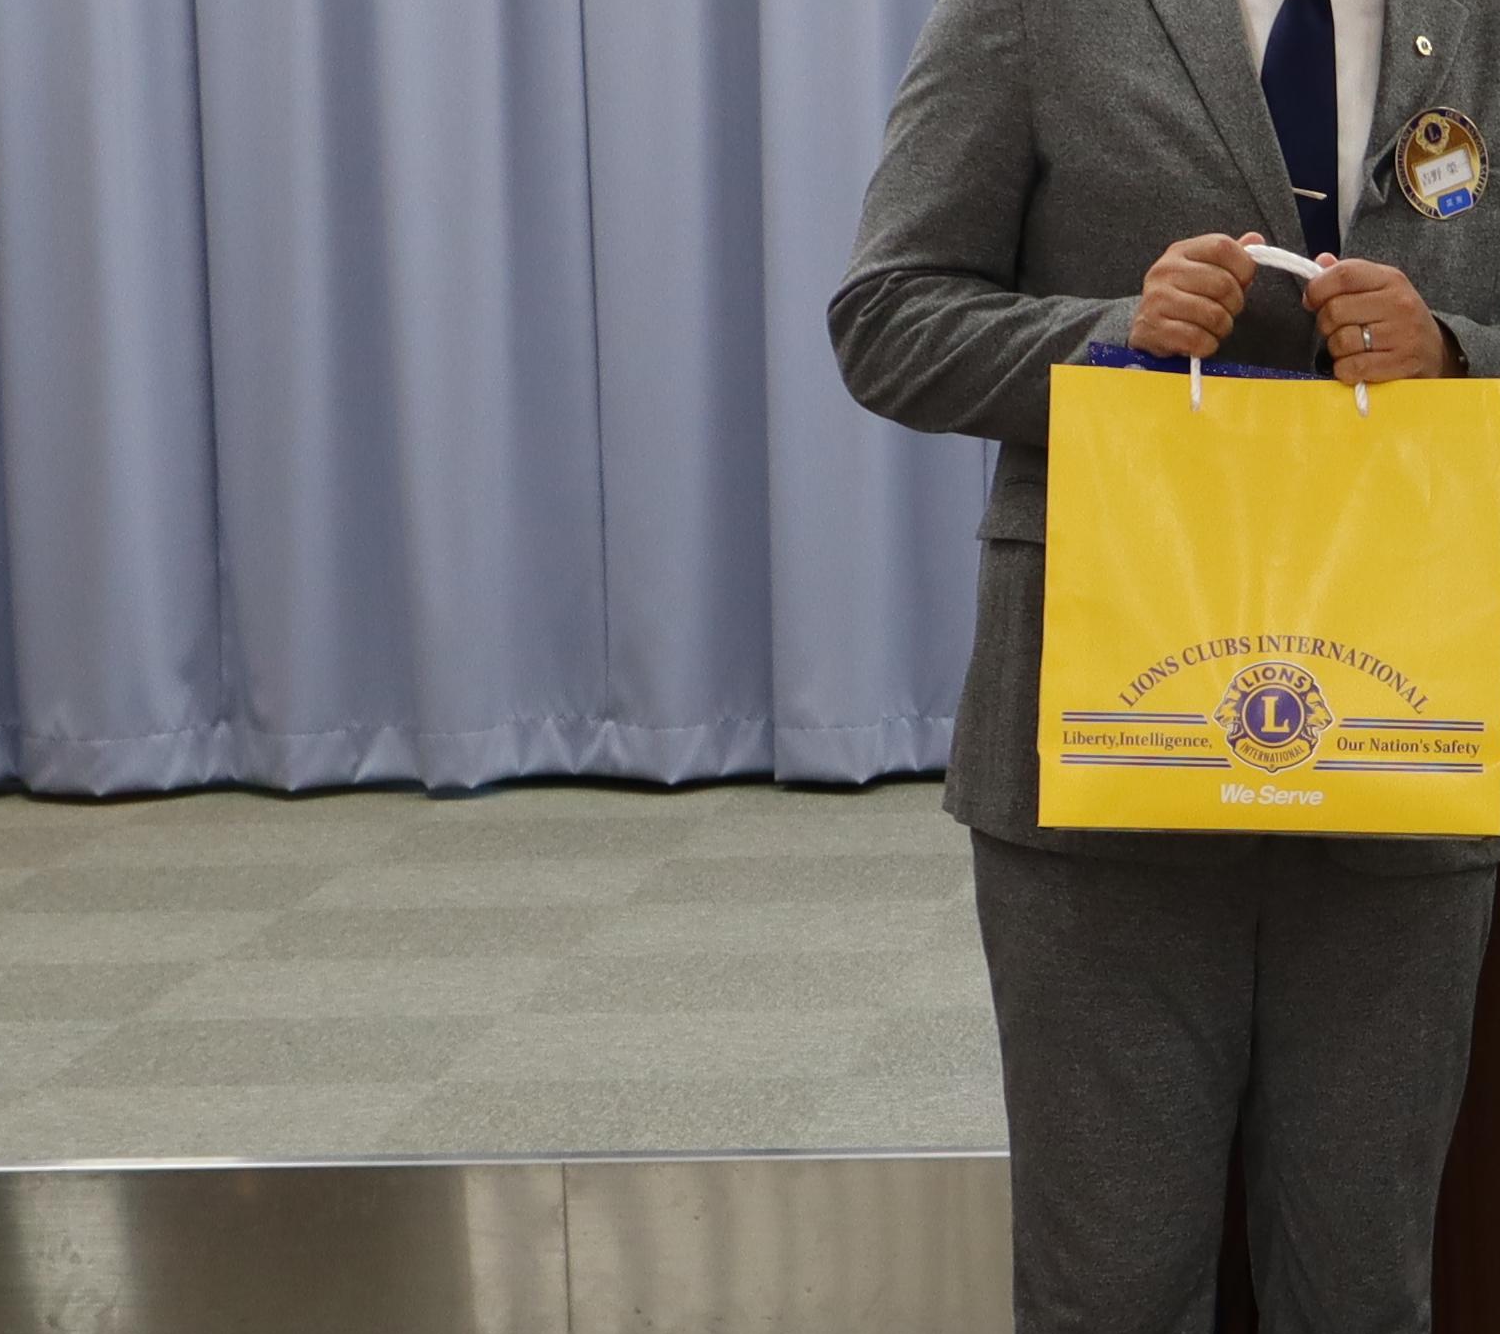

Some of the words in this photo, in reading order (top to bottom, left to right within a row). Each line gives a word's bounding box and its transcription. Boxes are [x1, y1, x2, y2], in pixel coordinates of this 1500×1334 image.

[1118, 656, 1180, 708] LIONS
[1182, 635, 1251, 667] CLUBS
[1258, 635, 1429, 714] INTERNATIONAL
[1242, 667, 1307, 691] LIONS
[1260, 696, 1289, 733] L
[1239, 745, 1306, 763] INTERNATIONAL
[1336, 736, 1365, 753] Our
[1369, 738, 1431, 754] Nation's
[1433, 740, 1480, 757] Safety
[1219, 784, 1255, 804] We
[1257, 785, 1324, 806] Serve
